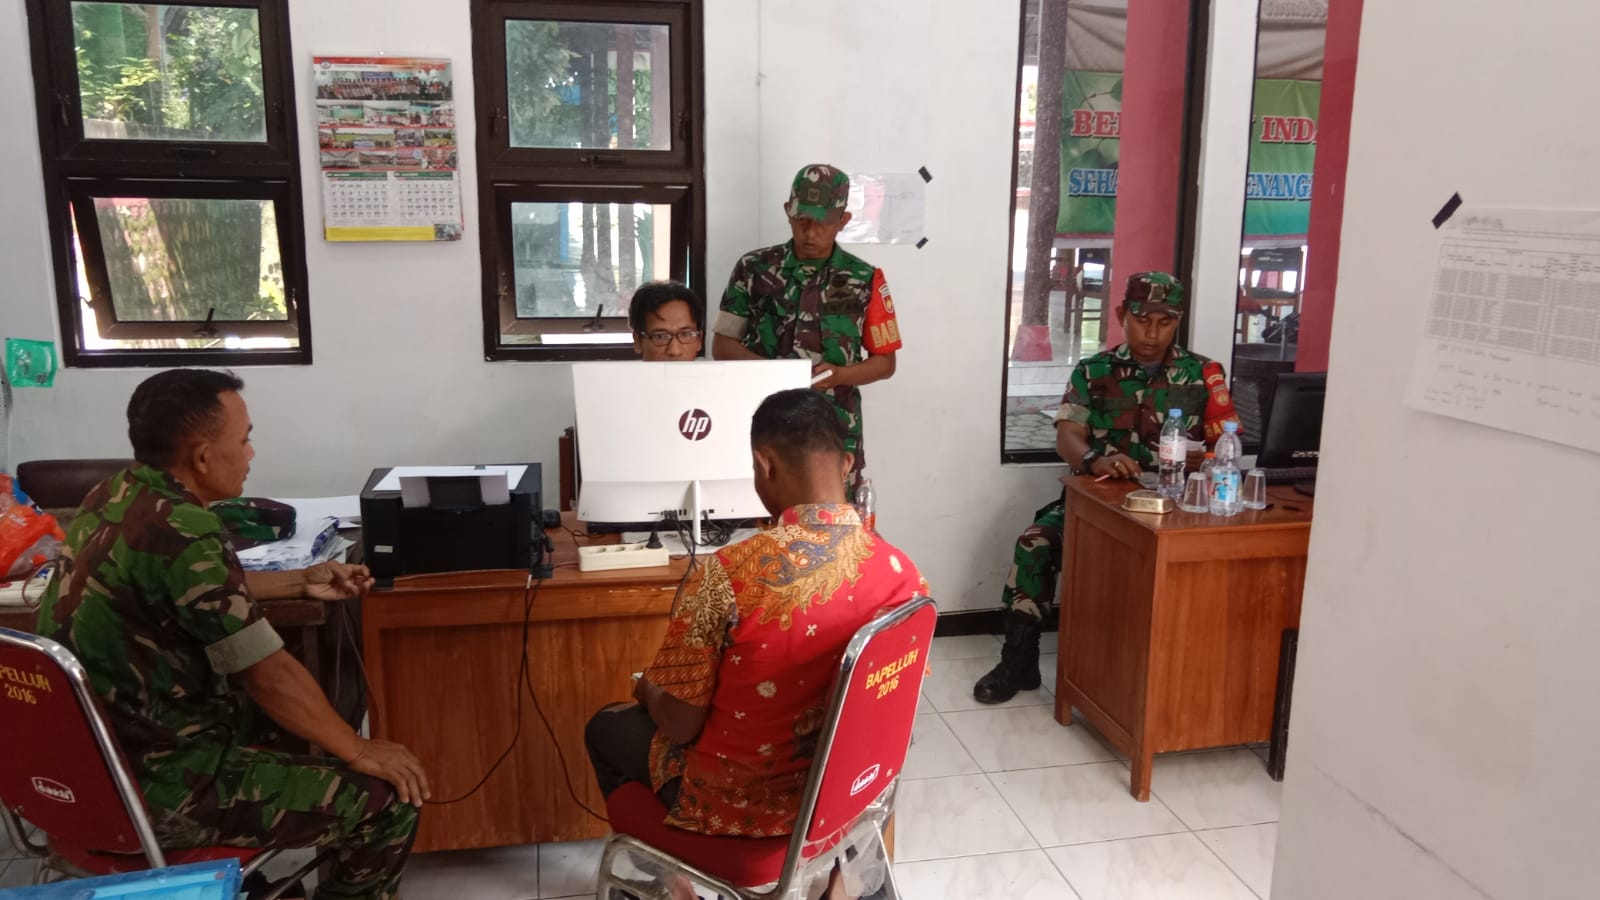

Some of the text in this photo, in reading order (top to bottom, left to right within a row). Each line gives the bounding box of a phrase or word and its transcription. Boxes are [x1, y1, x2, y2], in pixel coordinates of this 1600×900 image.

[1071, 109, 1317, 143] BE IND
[682, 409, 709, 441] hp
[865, 648, 919, 690] BAPELLUH
[4, 682, 37, 705] 2016
[876, 674, 900, 700] 2016
